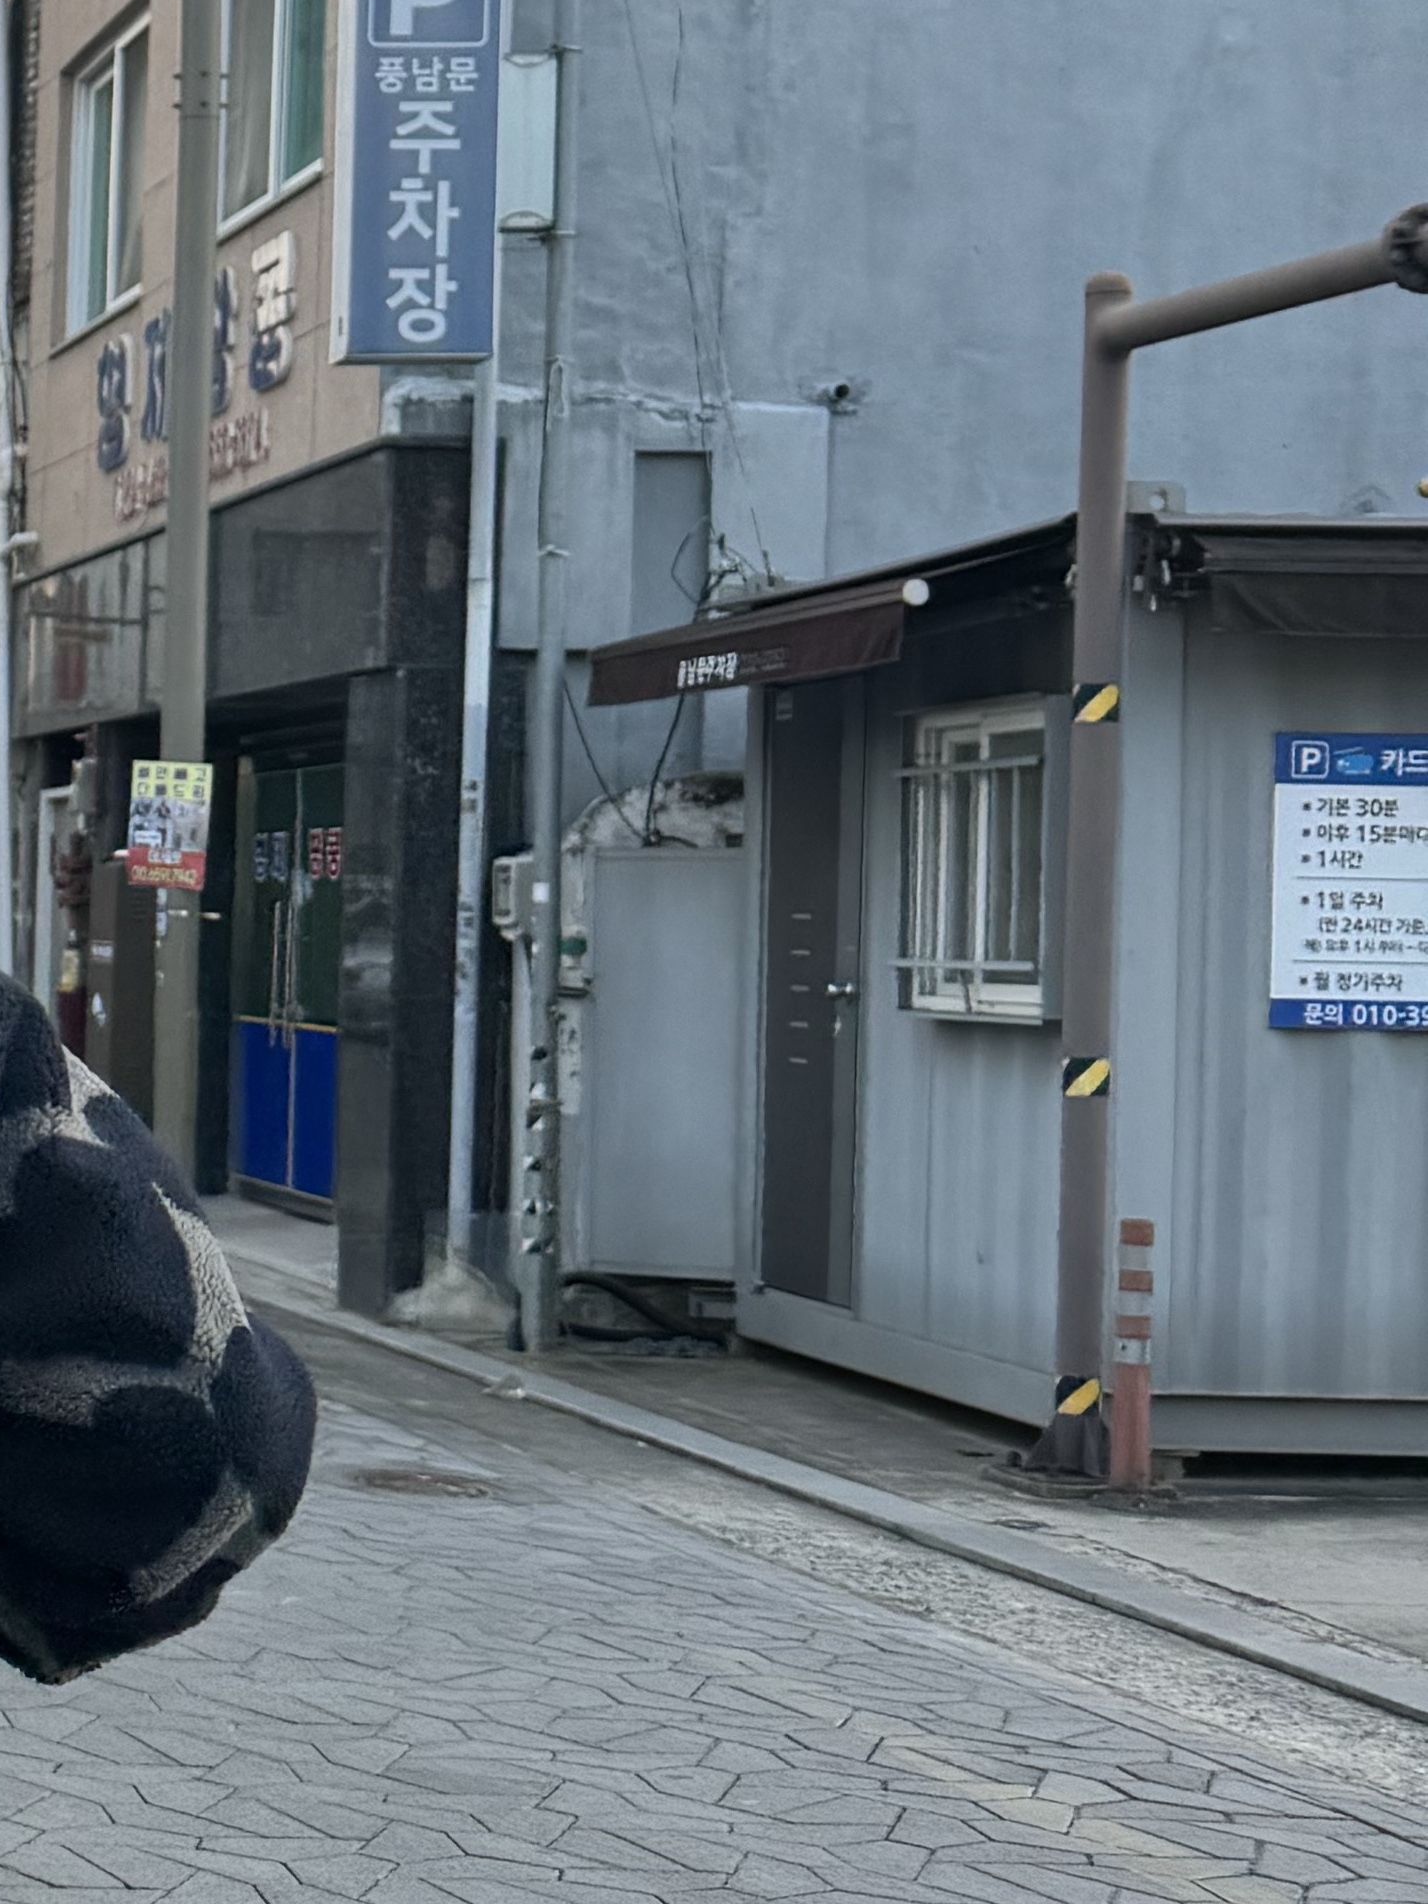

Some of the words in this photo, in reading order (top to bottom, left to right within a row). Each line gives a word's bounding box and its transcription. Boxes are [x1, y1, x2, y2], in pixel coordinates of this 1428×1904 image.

[374, 56, 478, 93] 풍남문
[385, 100, 461, 343] 주차장
[1300, 747, 1322, 774] P
[1316, 798, 1351, 817] 기본
[1355, 798, 1399, 817] 30분
[1316, 823, 1350, 842] 이후
[1317, 849, 1364, 869] 1시간
[1303, 1002, 1343, 1026] 문의
